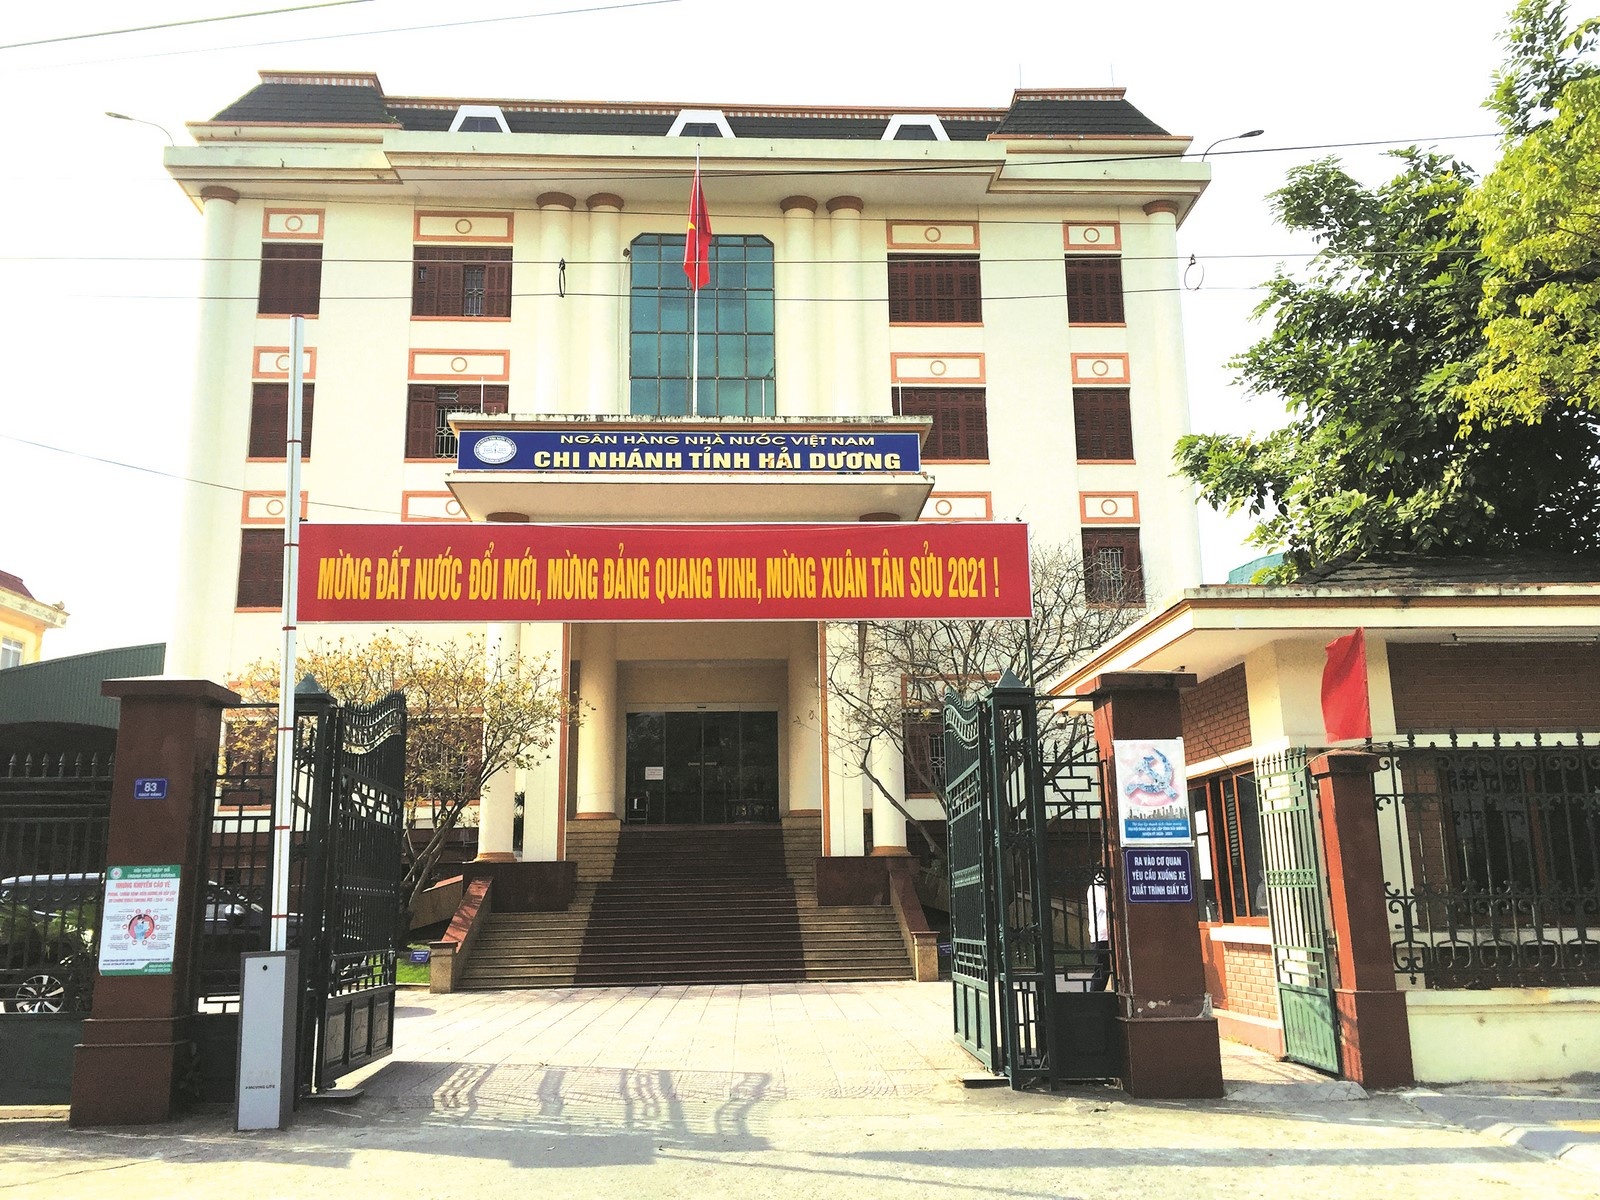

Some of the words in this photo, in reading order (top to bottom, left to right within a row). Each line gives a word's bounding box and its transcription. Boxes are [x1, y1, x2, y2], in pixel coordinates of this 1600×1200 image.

[560, 433, 617, 445] NGÂN
[623, 432, 680, 445] HÀNG
[685, 432, 725, 445] NHÀ
[729, 433, 786, 445] NƯỚC
[791, 434, 827, 448] VIỆT
[831, 436, 875, 446] NAM
[533, 451, 580, 469] CHI
[588, 448, 682, 469] NHÁNH
[688, 446, 750, 469] TỈNH
[758, 446, 801, 469] HẢI
[809, 451, 901, 470] DƯƠNG
[316, 548, 371, 600] MỪNG
[375, 545, 410, 600] ĐẤT
[413, 546, 462, 600] NƯỚC
[468, 541, 499, 600] ĐỔI
[503, 546, 542, 606] MỚI,
[547, 549, 599, 600] MỪNG
[603, 542, 650, 600] ĐẢNG
[655, 556, 713, 600] QUANG
[717, 556, 762, 605] VINH,
[766, 548, 817, 599] MỪNG
[821, 548, 868, 599] XUÂN
[871, 548, 905, 598] TÂN
[910, 540, 943, 598] SỬU
[948, 556, 986, 598] 2021
[993, 556, 1000, 598] !
[144, 782, 157, 792] 83
[1134, 856, 1143, 866] RA
[1143, 854, 1155, 866] VÀO
[1156, 855, 1165, 866] CƠ
[1165, 856, 1182, 867] QUAN
[1132, 869, 1143, 881] YÊU
[1157, 868, 1178, 881] XUỐNG
[1178, 871, 1186, 881] XE
[1131, 882, 1147, 895] XUẤT
[1147, 883, 1166, 895] TRÌNH
[1166, 882, 1180, 895] GIẤY
[1180, 883, 1189, 895] TỜ
